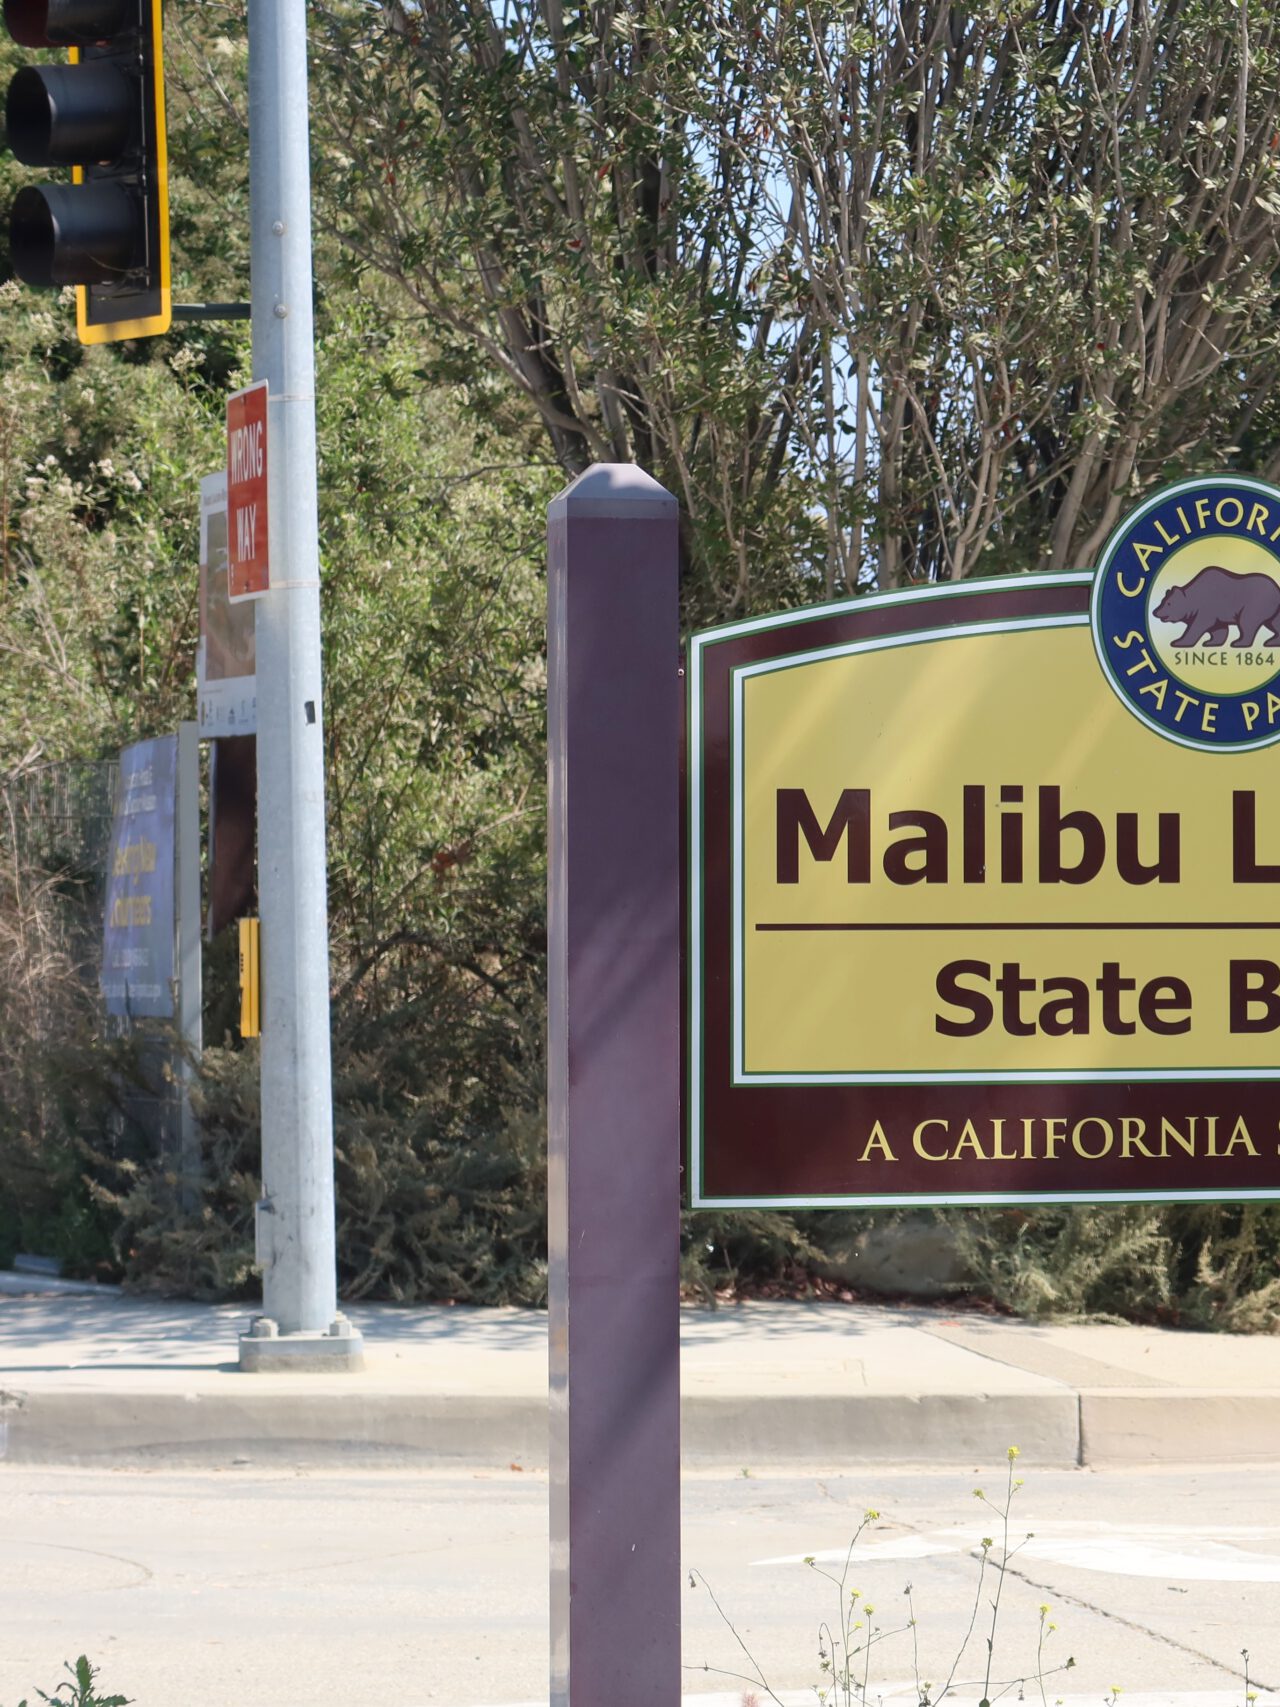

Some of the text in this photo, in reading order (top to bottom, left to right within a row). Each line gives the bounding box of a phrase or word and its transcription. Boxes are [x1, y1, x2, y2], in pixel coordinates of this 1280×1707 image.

[230, 420, 263, 485] WRONG
[236, 504, 257, 562] WAY
[1113, 630, 1219, 733] STATE
[1174, 651, 1276, 666] SINCE 1864
[776, 785, 1181, 886] Malibu
[935, 959, 1193, 1037] State
[856, 1119, 899, 1162] A
[912, 1115, 1261, 1161] CALIFORNIA
